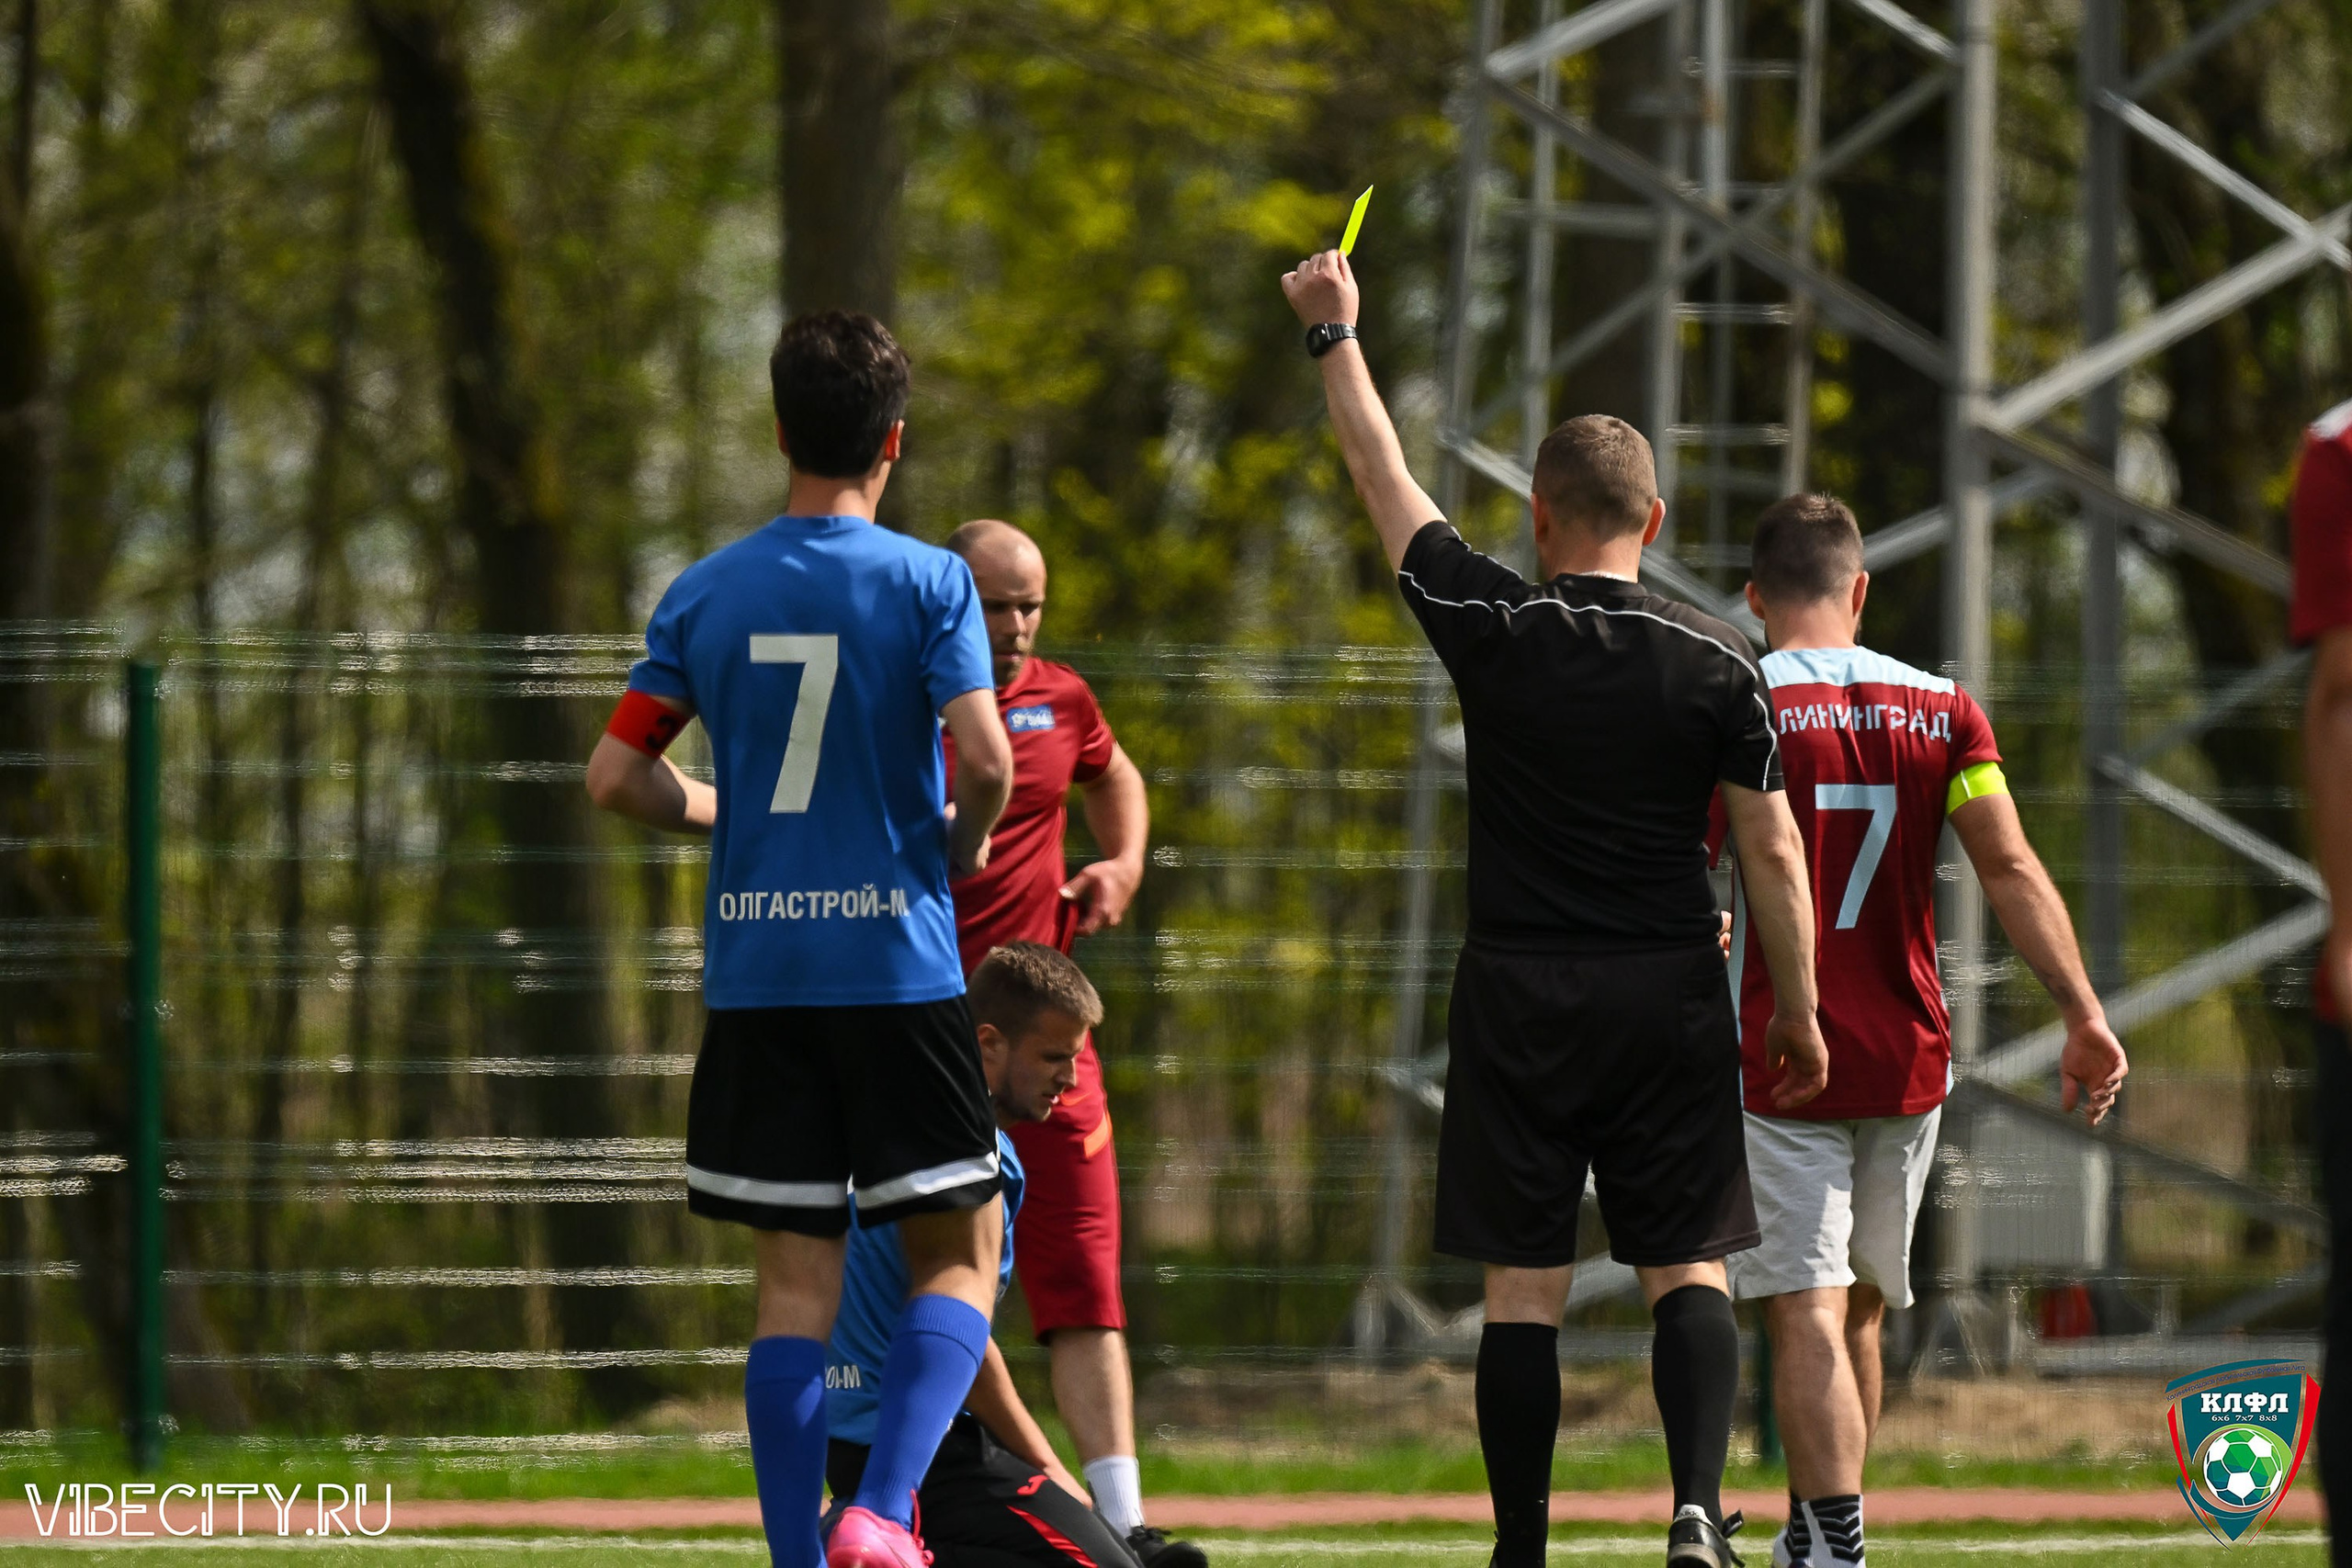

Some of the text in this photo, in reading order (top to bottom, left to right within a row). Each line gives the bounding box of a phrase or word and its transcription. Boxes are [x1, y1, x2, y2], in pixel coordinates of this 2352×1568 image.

[749, 635, 838, 813] 7
[1780, 703, 1951, 744] ЛИНИНГРАД
[719, 884, 910, 921] ОЛГАСТРОЙ-М
[1815, 784, 1897, 930] 7
